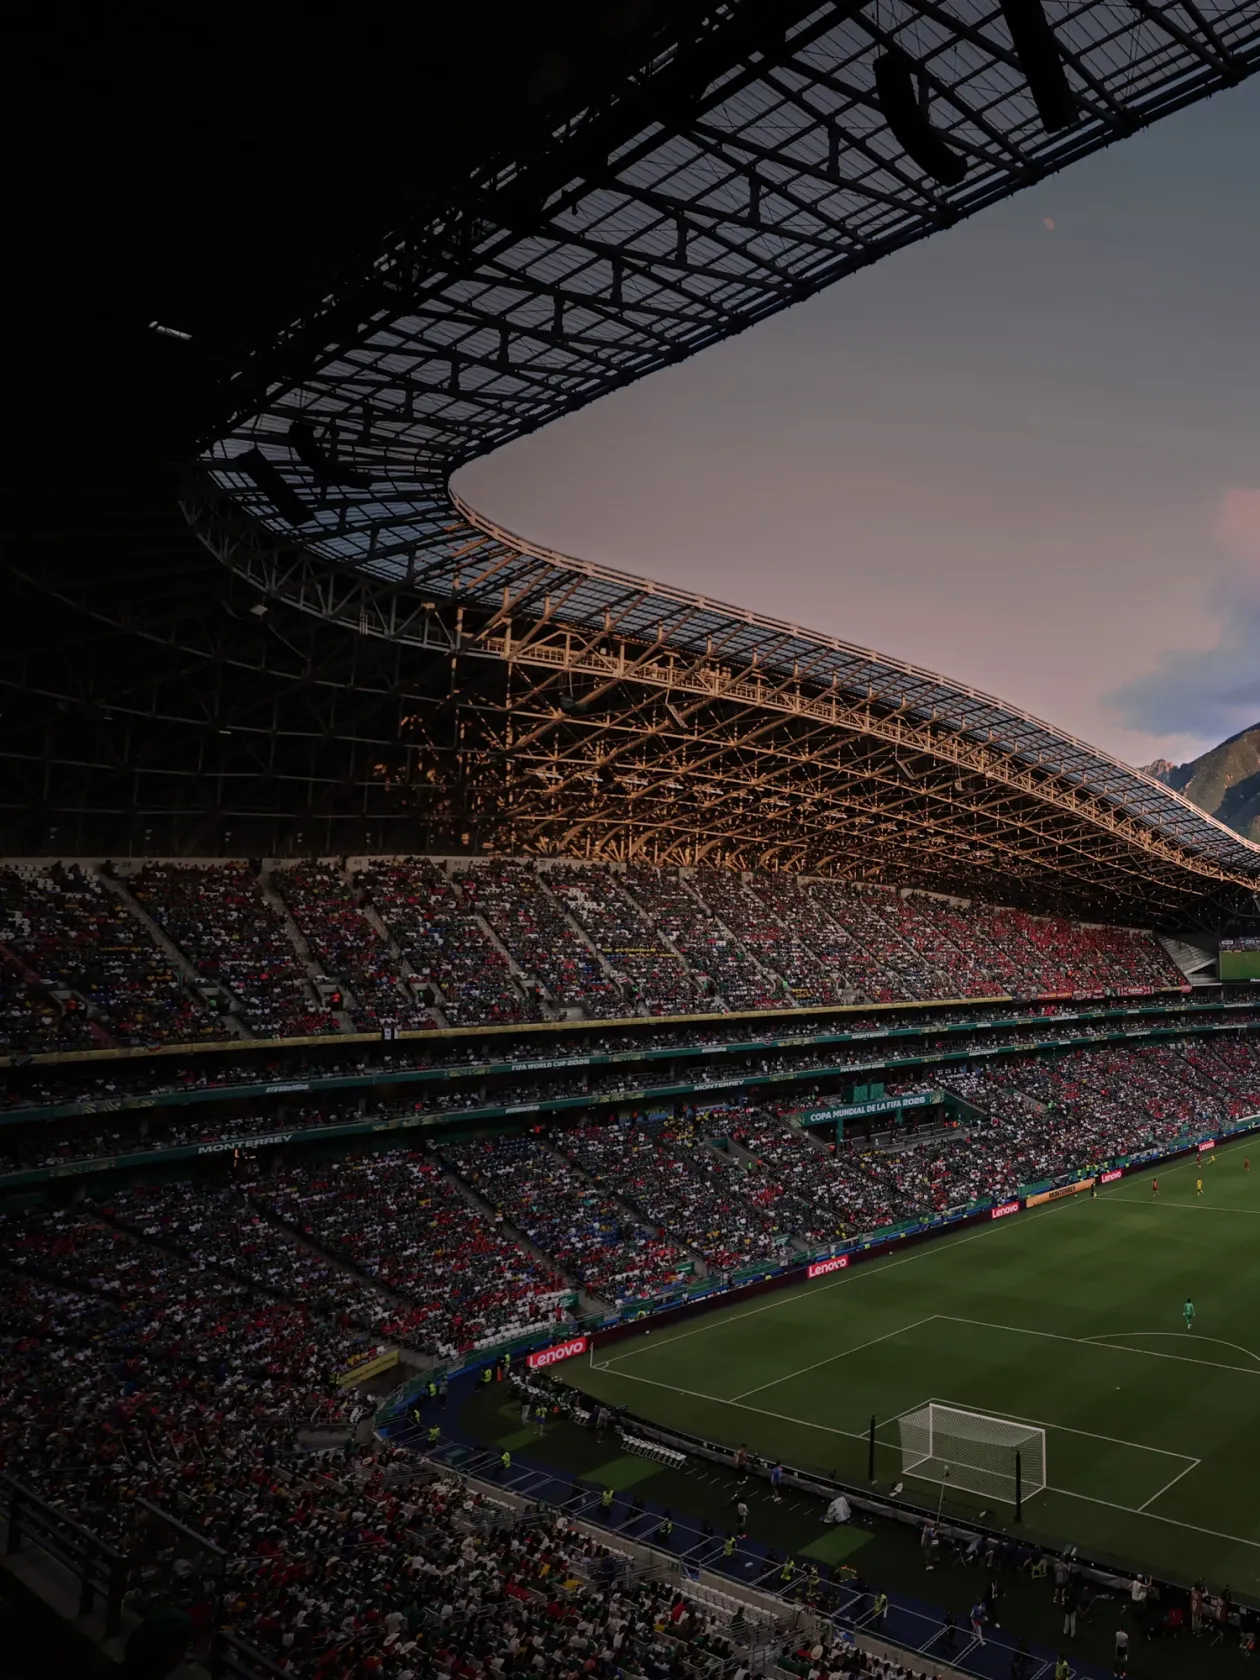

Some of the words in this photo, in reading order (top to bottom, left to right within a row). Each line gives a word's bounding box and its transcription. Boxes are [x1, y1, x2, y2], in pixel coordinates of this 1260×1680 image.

[694, 1080, 744, 1091] MONTERREY
[810, 1112, 832, 1122] COPA
[832, 1107, 866, 1118] MUNDIAL
[866, 1104, 876, 1113] DE
[877, 1103, 886, 1111] LA
[887, 1100, 901, 1109] FIFA
[902, 1096, 925, 1106] 2026
[198, 1135, 292, 1154] MONTERREY
[1101, 1171, 1122, 1183] Lenovo
[992, 1204, 1019, 1218] Lenovo
[809, 1258, 847, 1277] Lenovo
[529, 1341, 583, 1368] Lenovo
